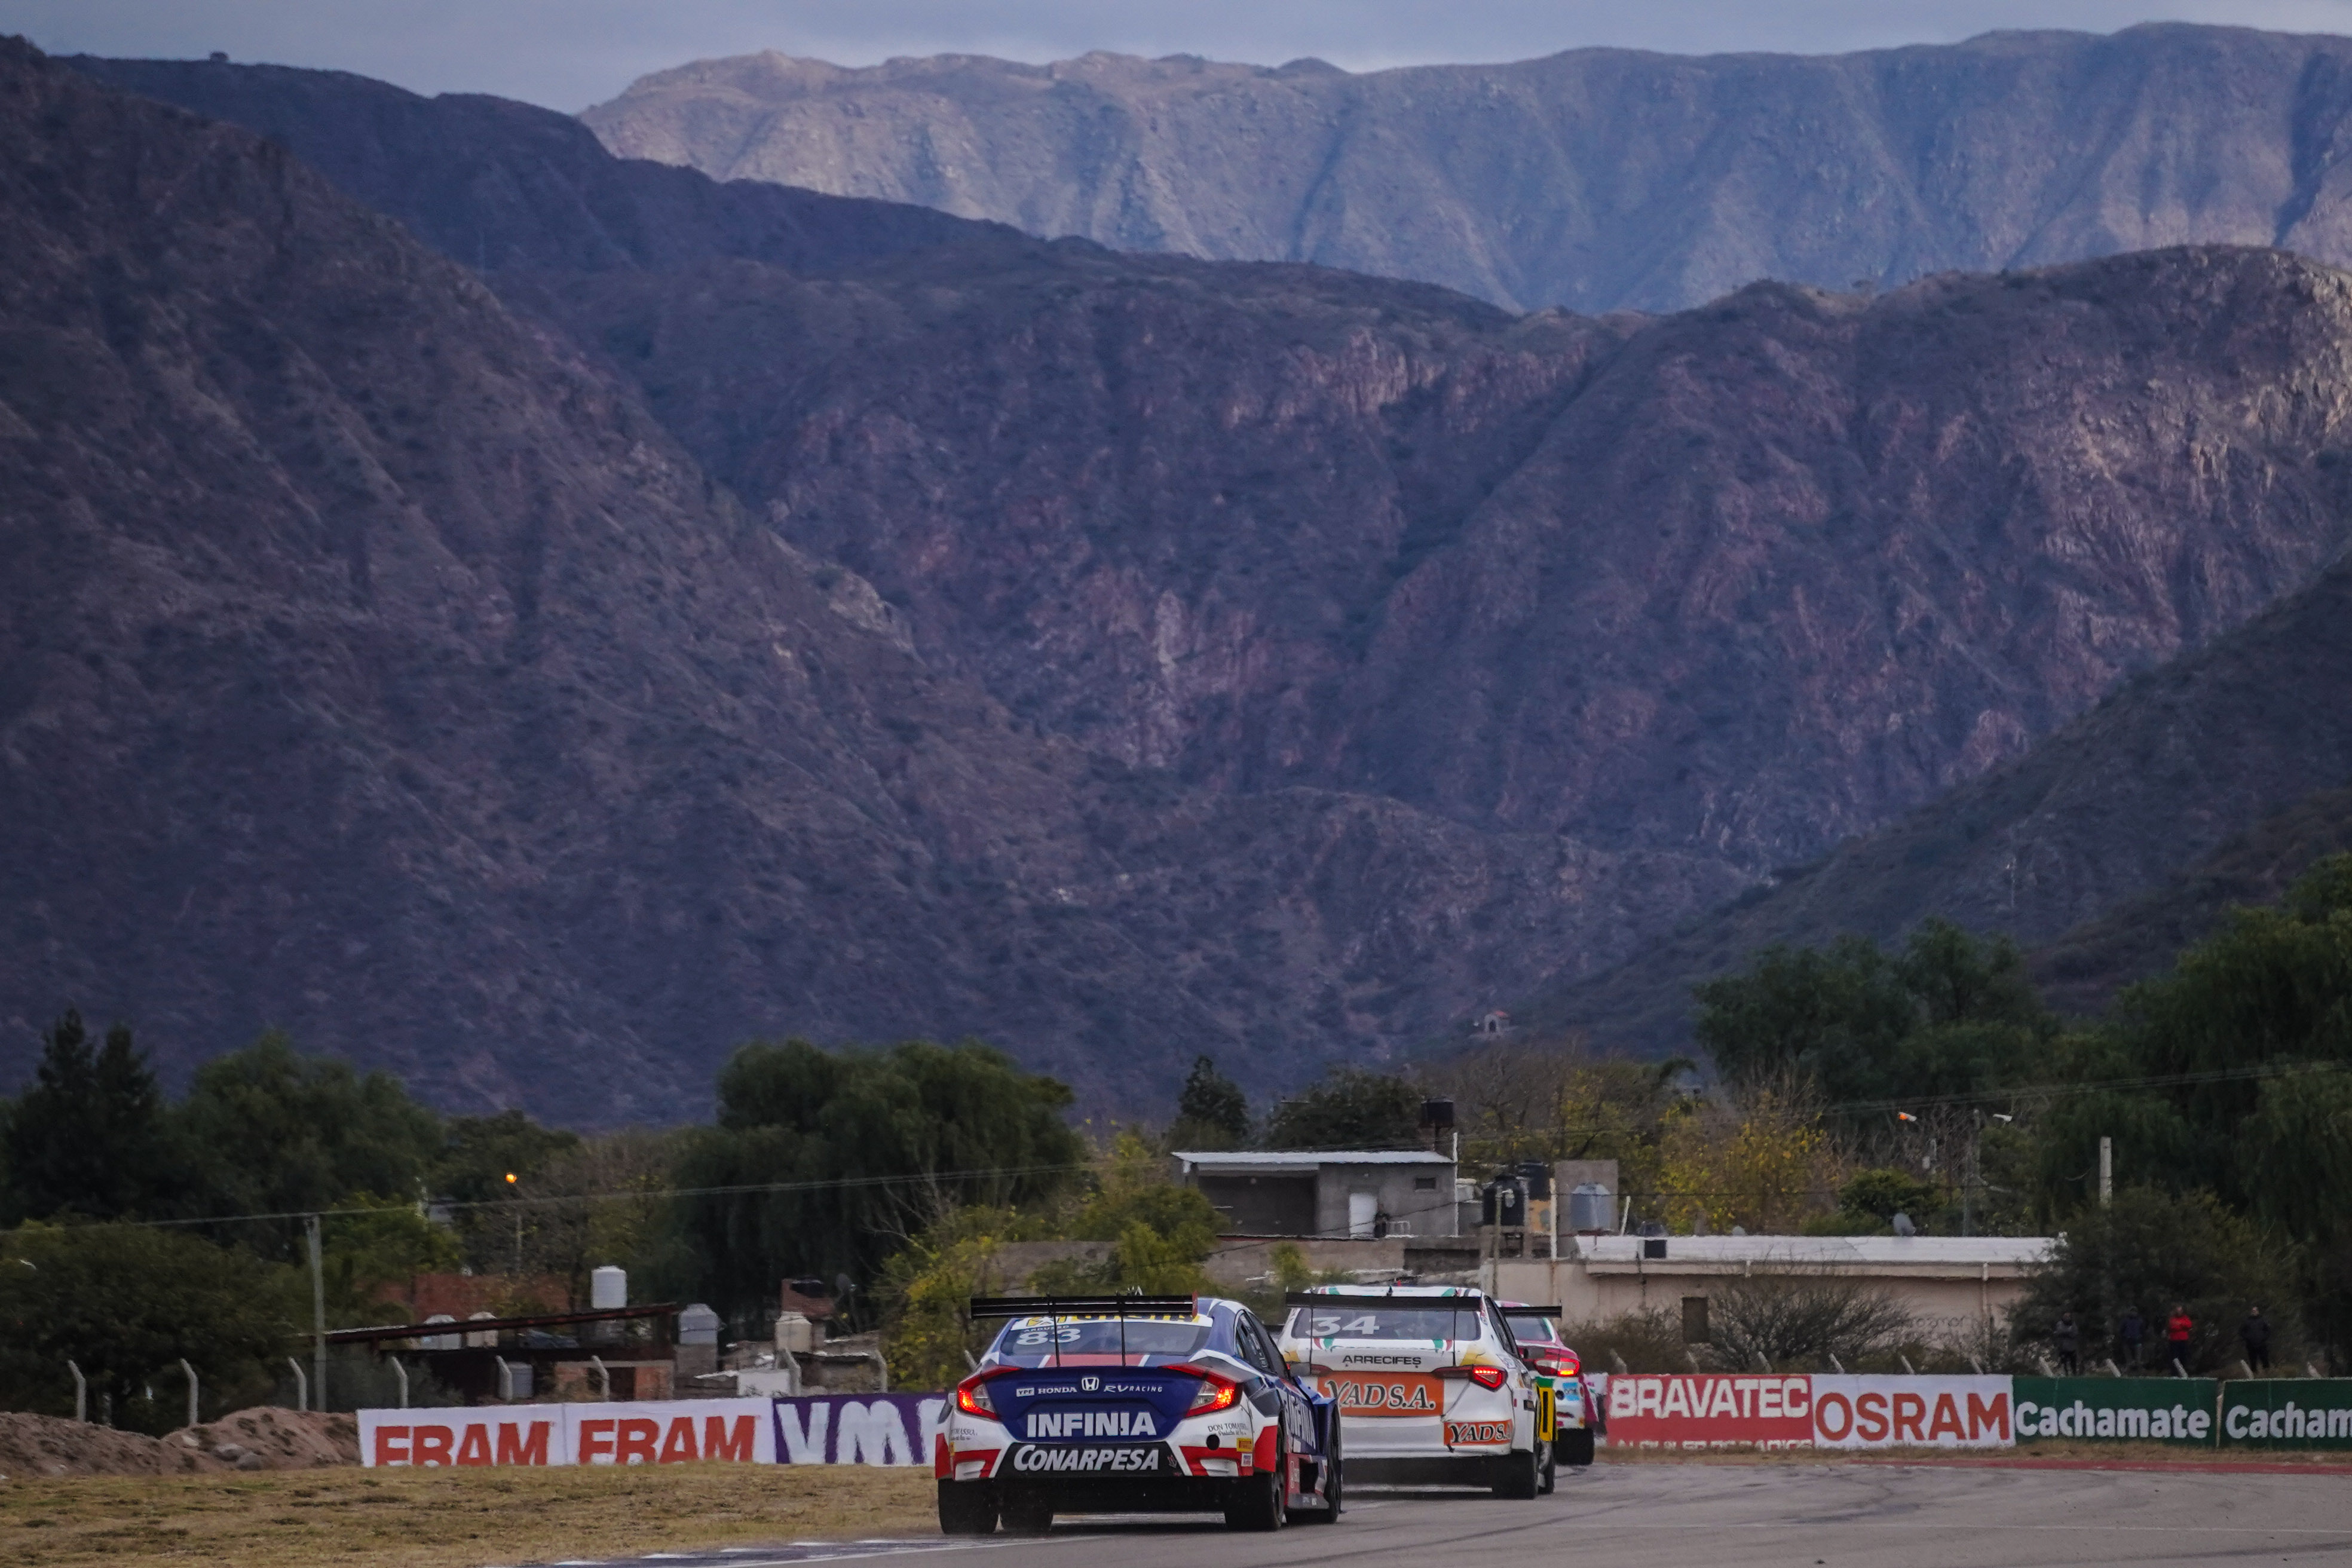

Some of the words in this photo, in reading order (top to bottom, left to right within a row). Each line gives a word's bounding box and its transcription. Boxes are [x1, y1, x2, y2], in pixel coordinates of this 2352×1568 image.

[1016, 1328, 1081, 1345] 83
[1305, 1315, 1380, 1337] 34
[1342, 1355, 1422, 1365] ARRECIFES
[1609, 1378, 1809, 1419] BRAVATEC
[1027, 1411, 1157, 1438] INFINIA
[1815, 1392, 2010, 1441] OSRAM
[2015, 1399, 2211, 1438] Cachamate
[375, 1420, 550, 1466] FRAM
[578, 1415, 757, 1464] FRAM
[1014, 1445, 1159, 1471] CONARPESA
